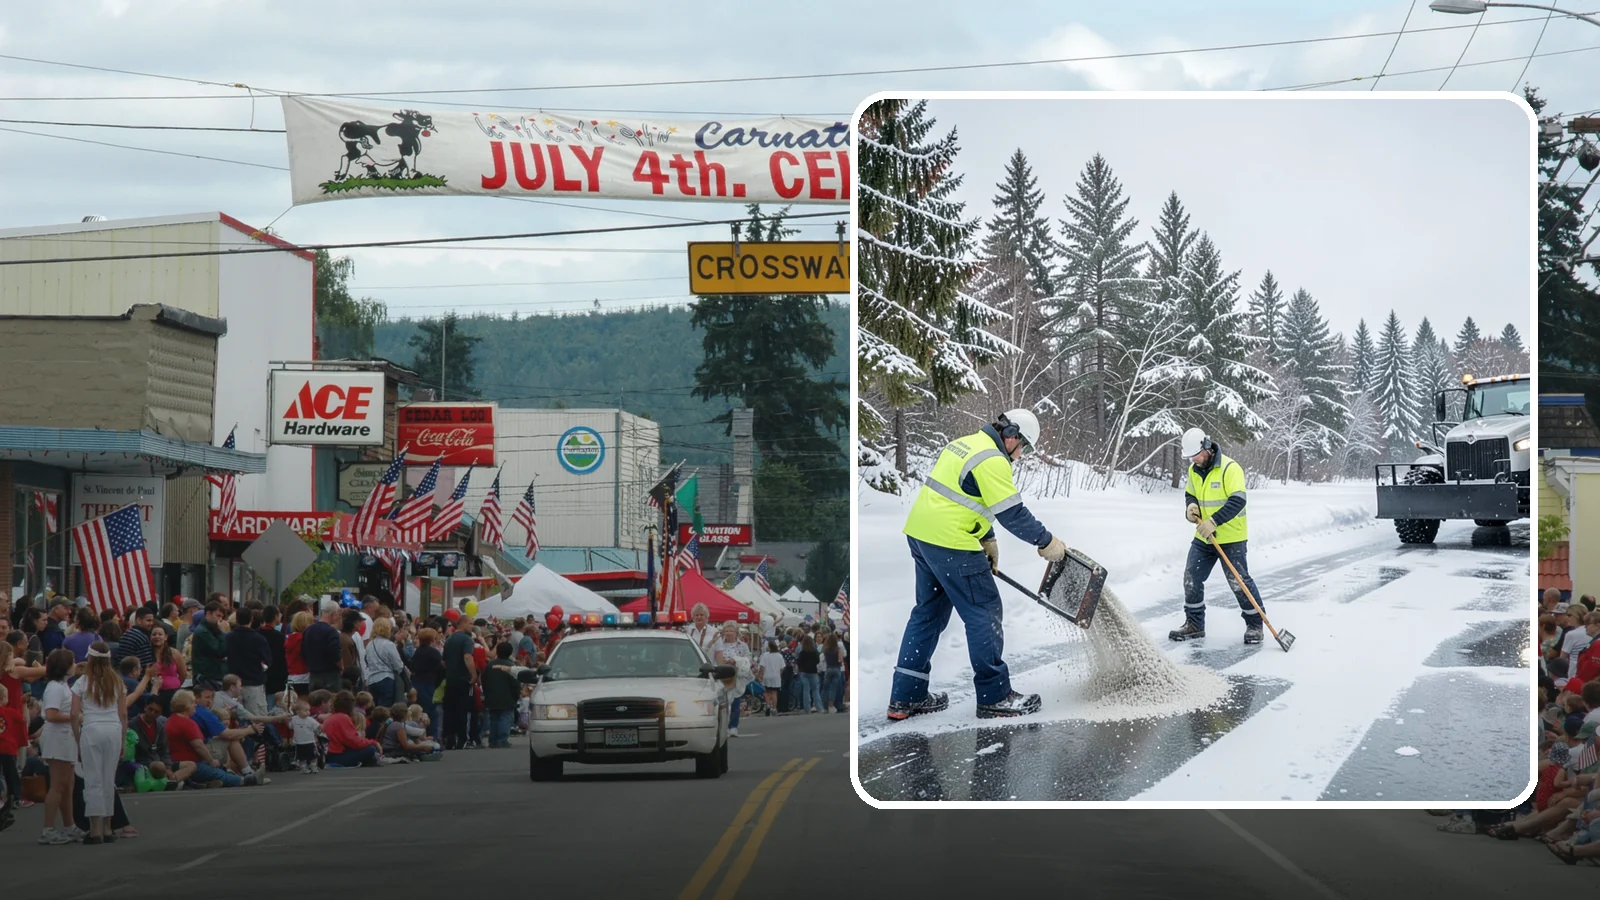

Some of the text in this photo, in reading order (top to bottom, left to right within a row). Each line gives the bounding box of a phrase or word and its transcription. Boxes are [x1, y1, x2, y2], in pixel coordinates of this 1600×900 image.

[481, 141, 605, 192] JULY
[632, 150, 747, 198] 4th.
[696, 254, 850, 280] CROSSWA
[283, 380, 373, 420] ACE
[405, 409, 485, 422] CEDAR LOG
[284, 421, 370, 436] Hardware
[416, 428, 476, 446] Coca-Cola
[353, 467, 387, 483] Simpl
[83, 485, 155, 495] St. Vincent de Paul
[213, 516, 331, 535] HARDARE
[688, 526, 741, 535] CRNATION
[699, 535, 730, 543] GLASS
